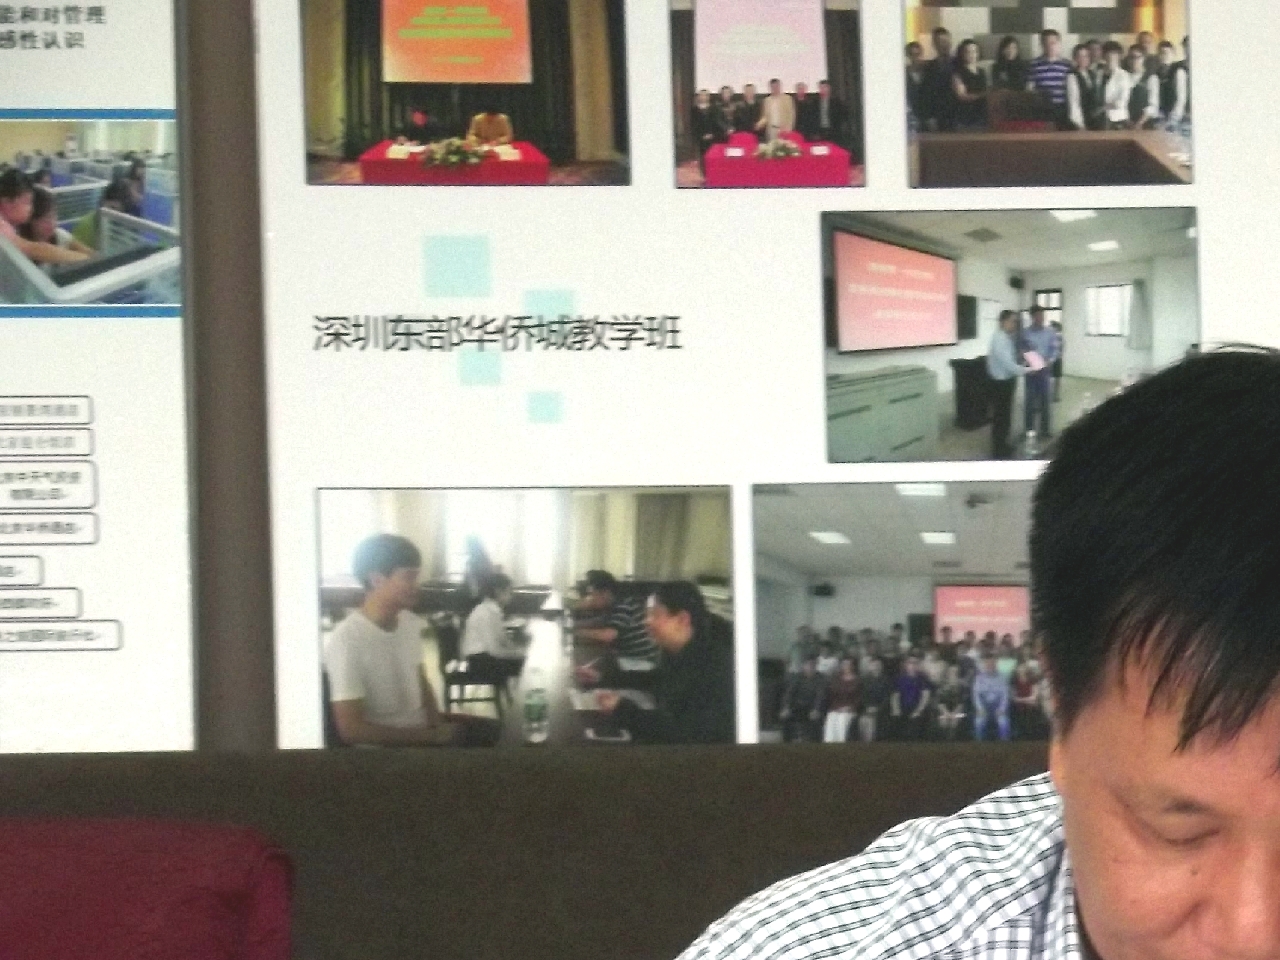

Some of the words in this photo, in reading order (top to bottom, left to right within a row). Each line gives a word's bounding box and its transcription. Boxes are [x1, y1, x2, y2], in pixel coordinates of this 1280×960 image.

[312, 314, 684, 352] 深圳东部华侨城教学班
